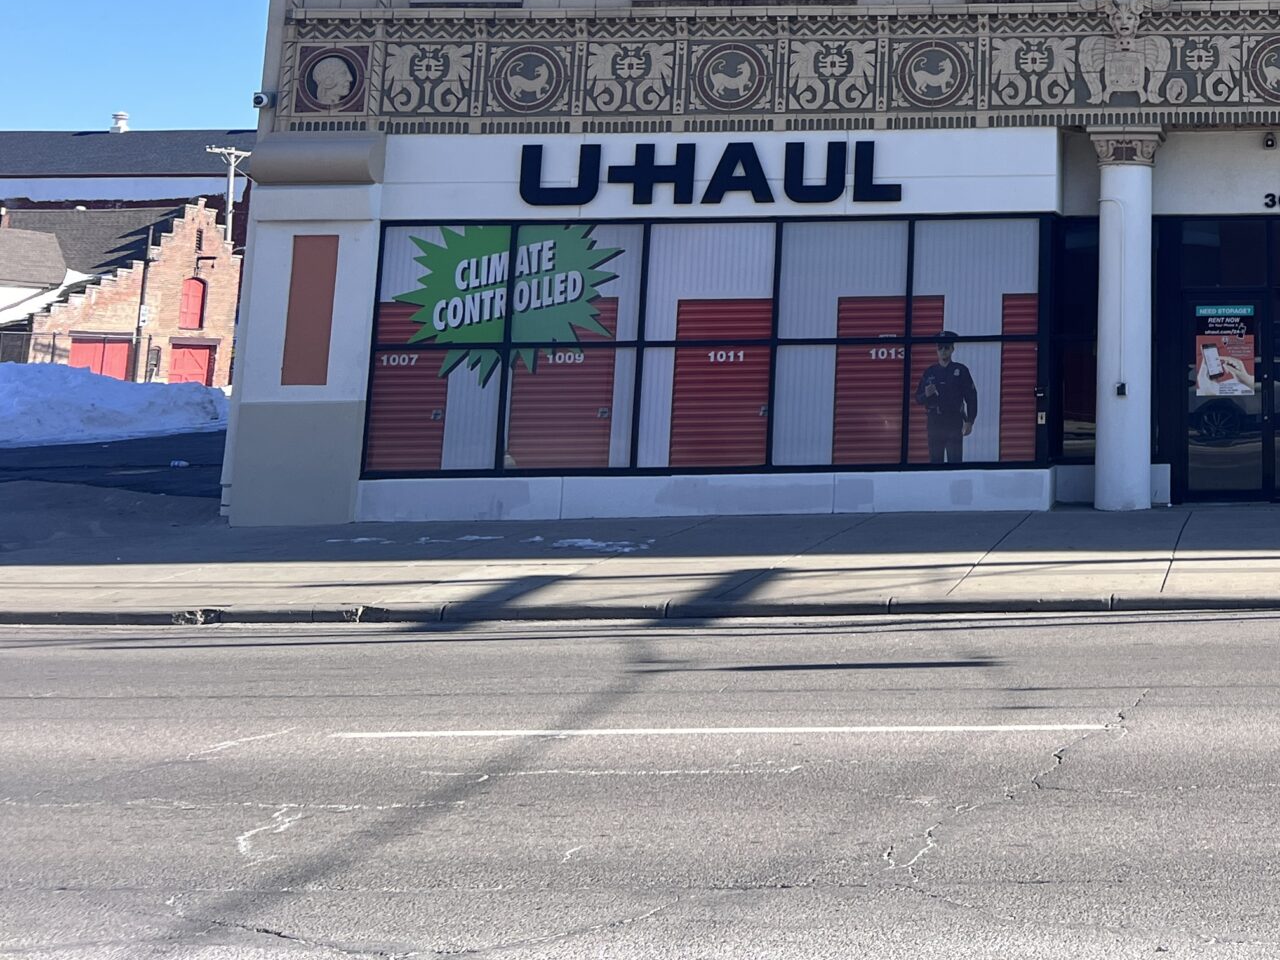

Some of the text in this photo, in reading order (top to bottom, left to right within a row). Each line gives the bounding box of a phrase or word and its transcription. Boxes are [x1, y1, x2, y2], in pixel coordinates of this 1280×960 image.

[519, 141, 902, 206] U-HAUL
[455, 240, 557, 291] CLIMATE
[432, 270, 584, 331] CONTROLLED
[546, 352, 584, 364] 1009
[708, 350, 744, 362] 1011
[869, 347, 905, 359] 1013
[381, 354, 419, 366] 1007
